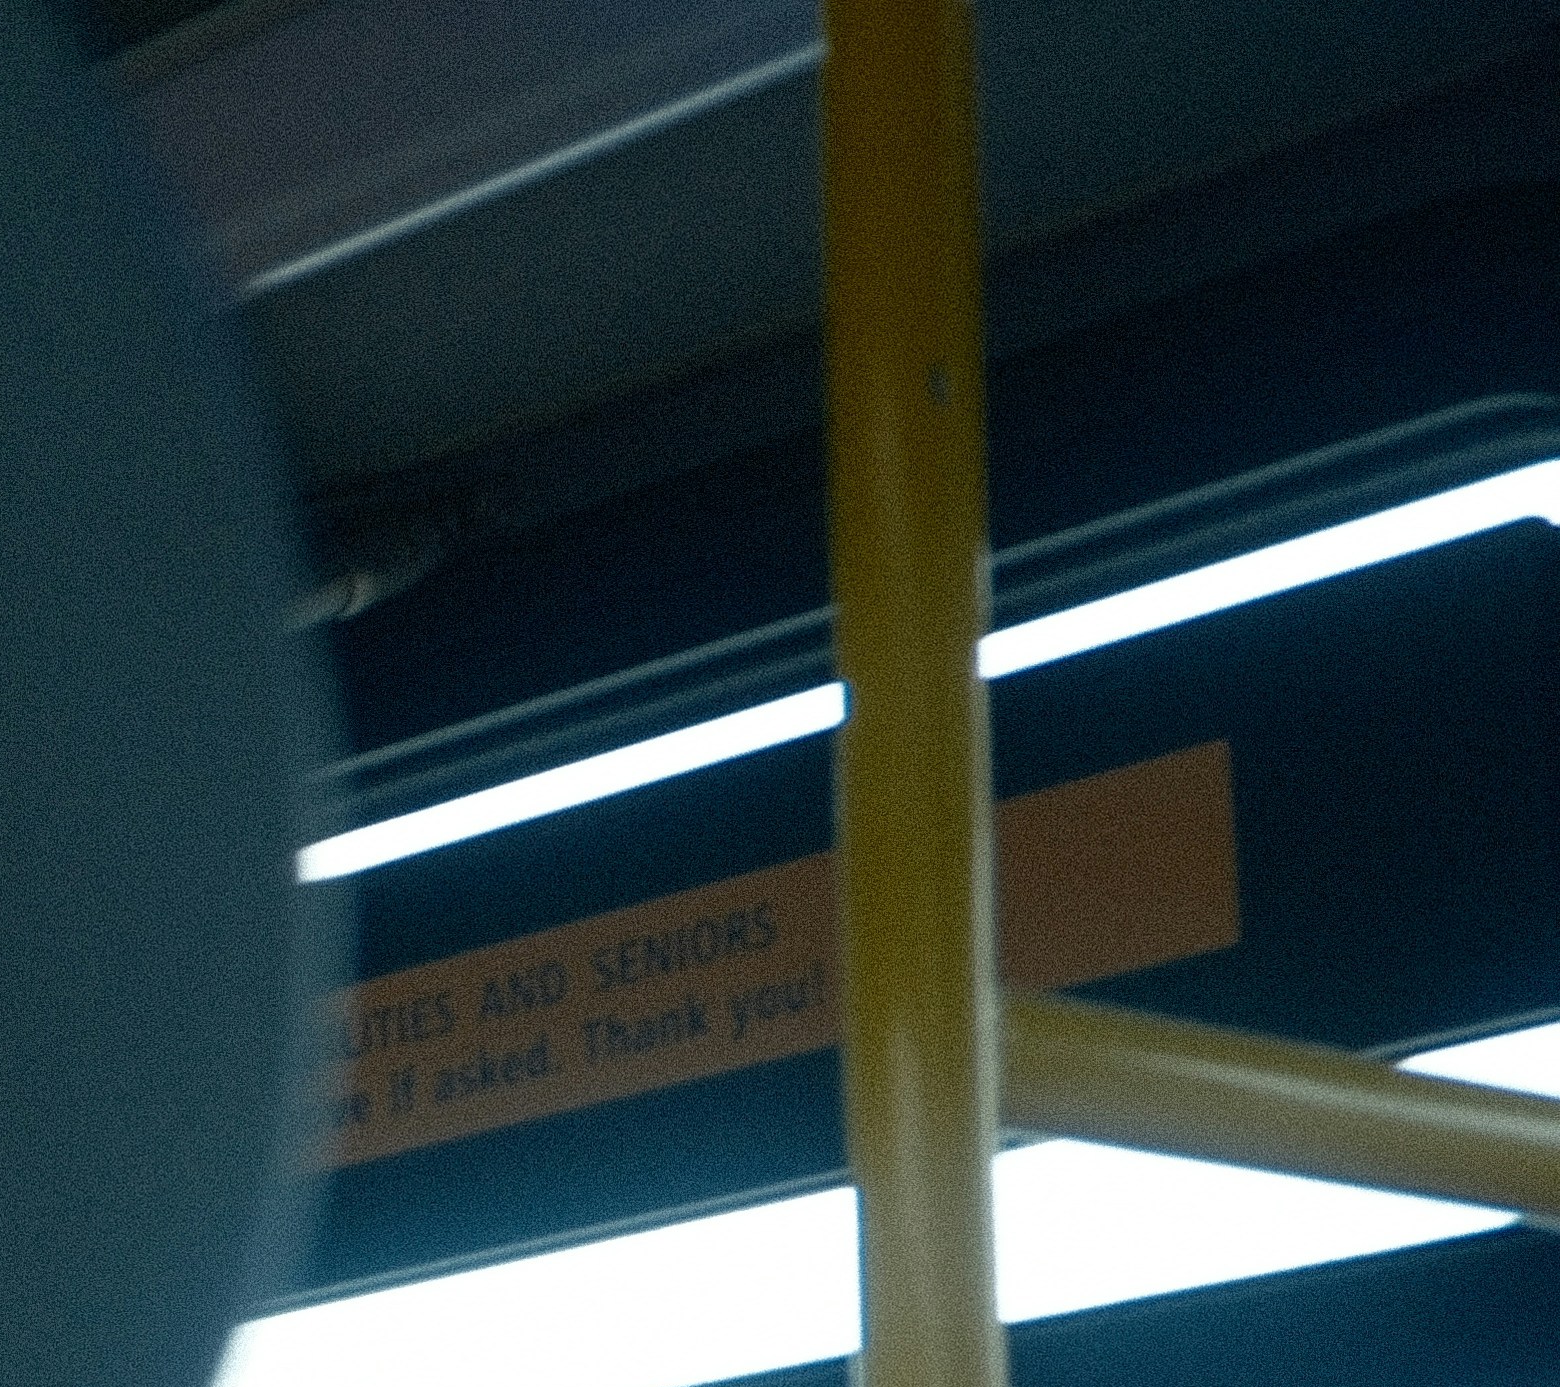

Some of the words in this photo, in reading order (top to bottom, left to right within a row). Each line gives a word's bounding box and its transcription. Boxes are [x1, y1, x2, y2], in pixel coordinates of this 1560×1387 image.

[478, 961, 567, 1021] AND
[592, 900, 777, 992] SENIORS
[583, 995, 709, 1066] Thank
[731, 959, 828, 1041] you!
